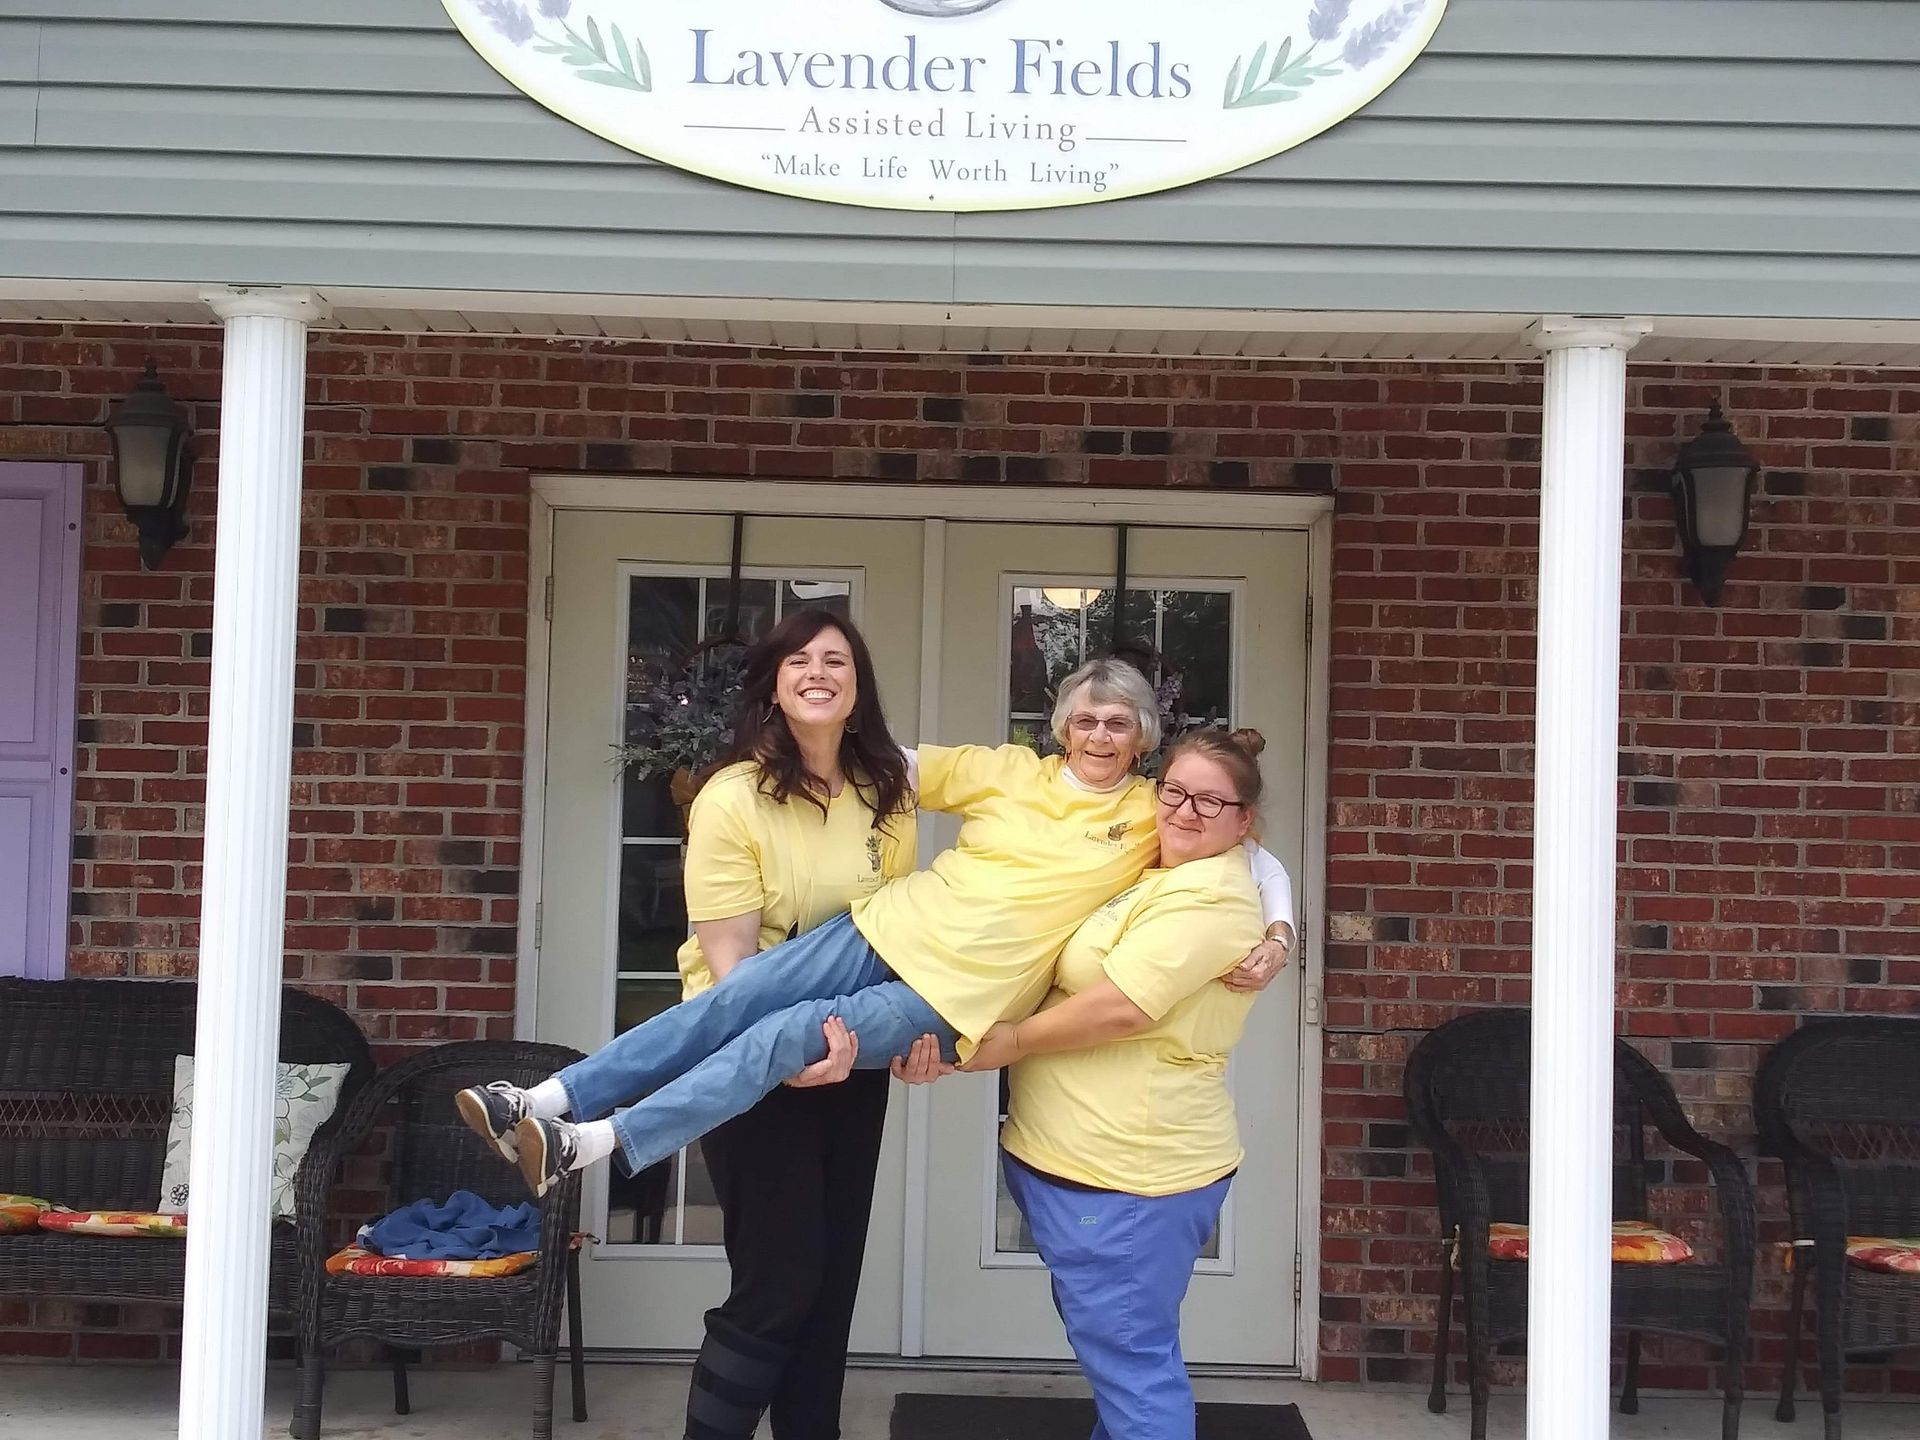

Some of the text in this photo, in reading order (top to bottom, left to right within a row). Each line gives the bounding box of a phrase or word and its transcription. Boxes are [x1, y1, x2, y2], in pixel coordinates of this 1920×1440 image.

[687, 28, 1192, 99] Lavender Fields
[798, 105, 1077, 153] Assisted Living
[761, 153, 1119, 193] “Make Life Worth Living”
